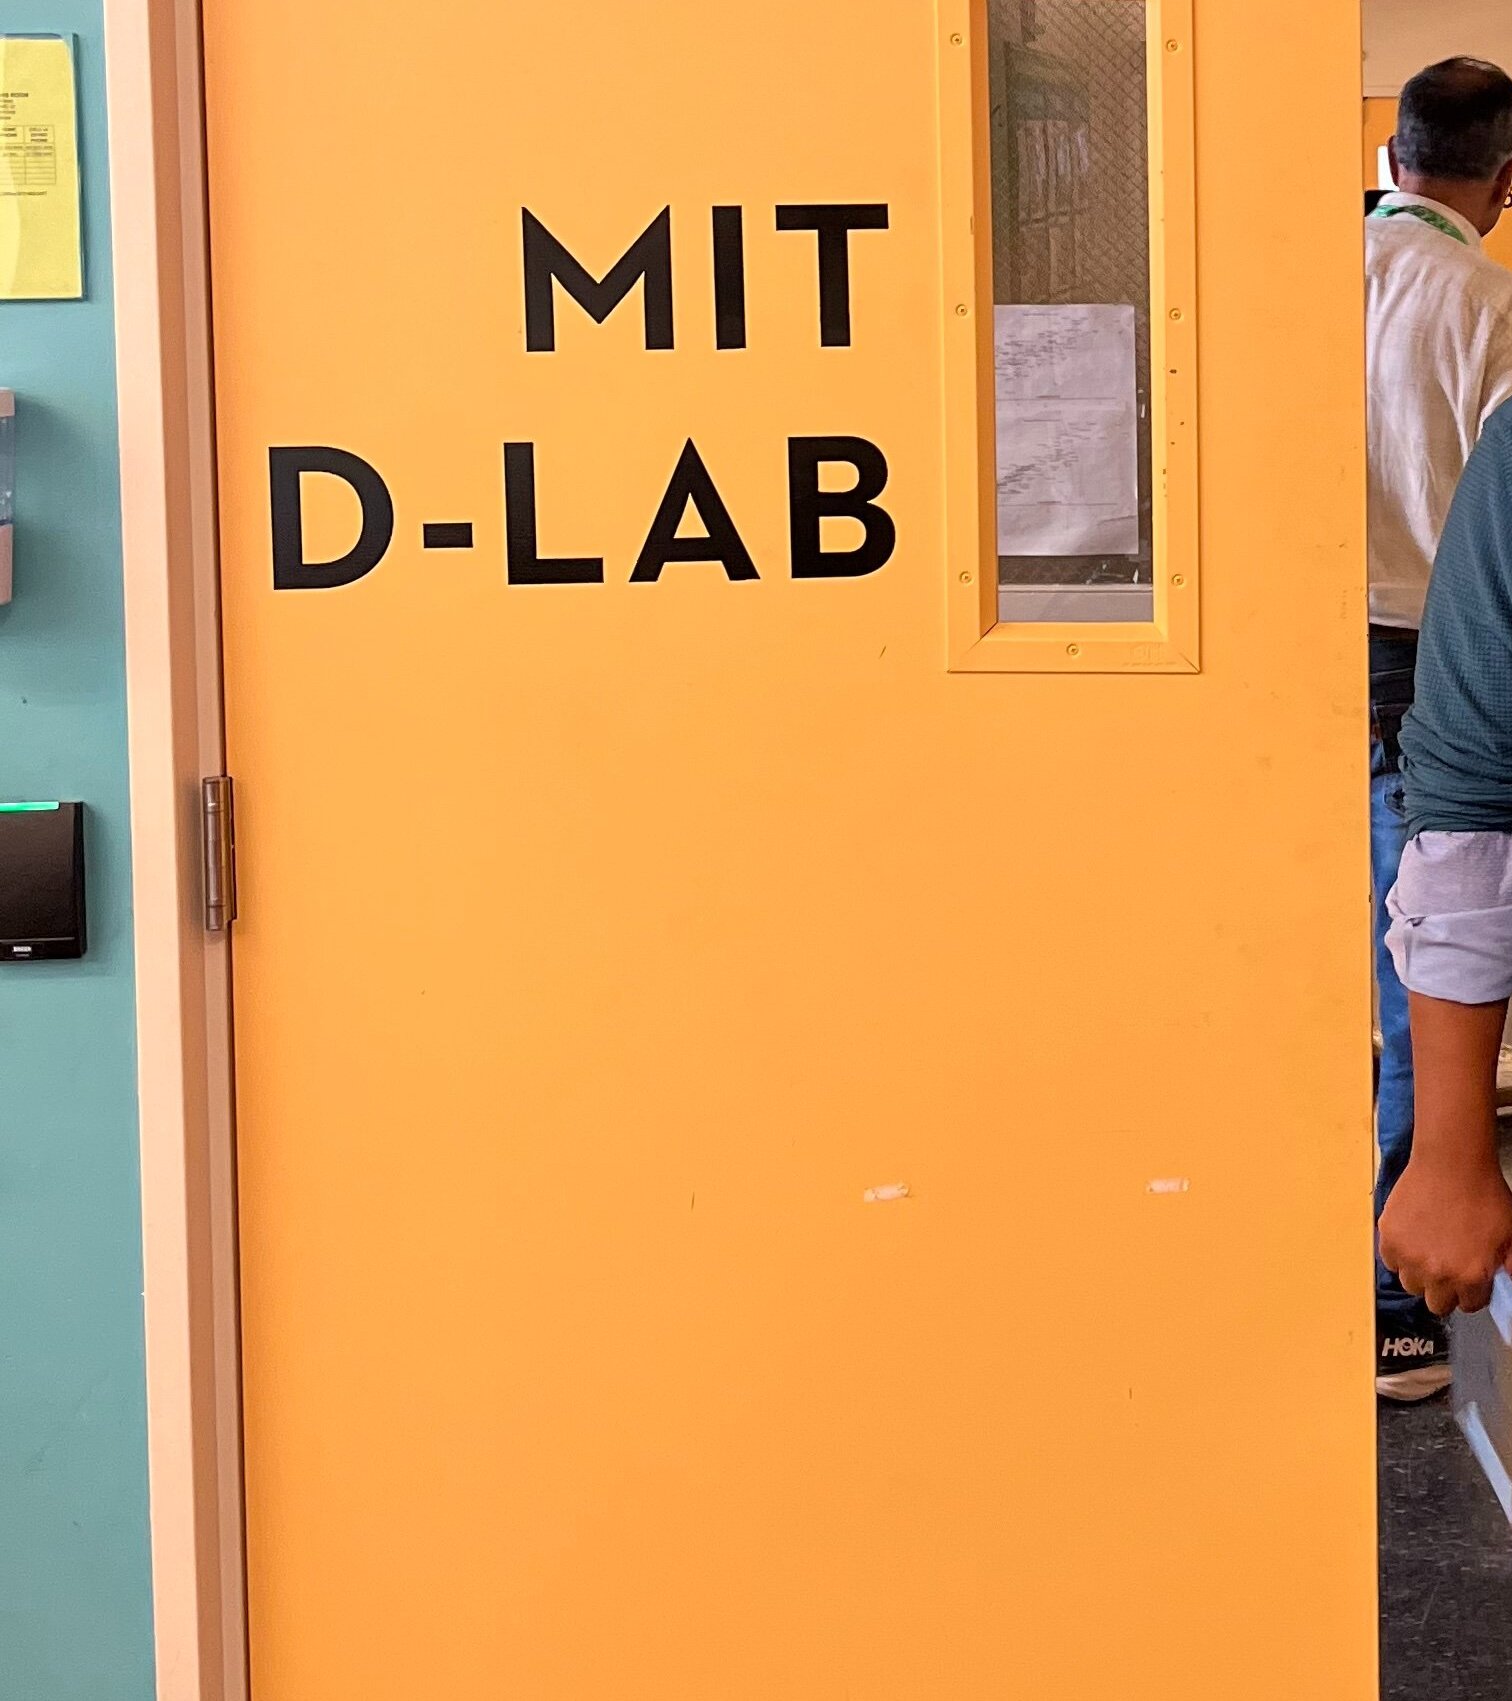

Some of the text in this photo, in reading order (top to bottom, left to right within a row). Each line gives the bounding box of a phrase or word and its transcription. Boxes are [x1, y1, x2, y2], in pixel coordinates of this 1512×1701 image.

[521, 203, 889, 353] MIT
[268, 436, 897, 591] D-LAB
[1381, 1336, 1434, 1357] HOKA
